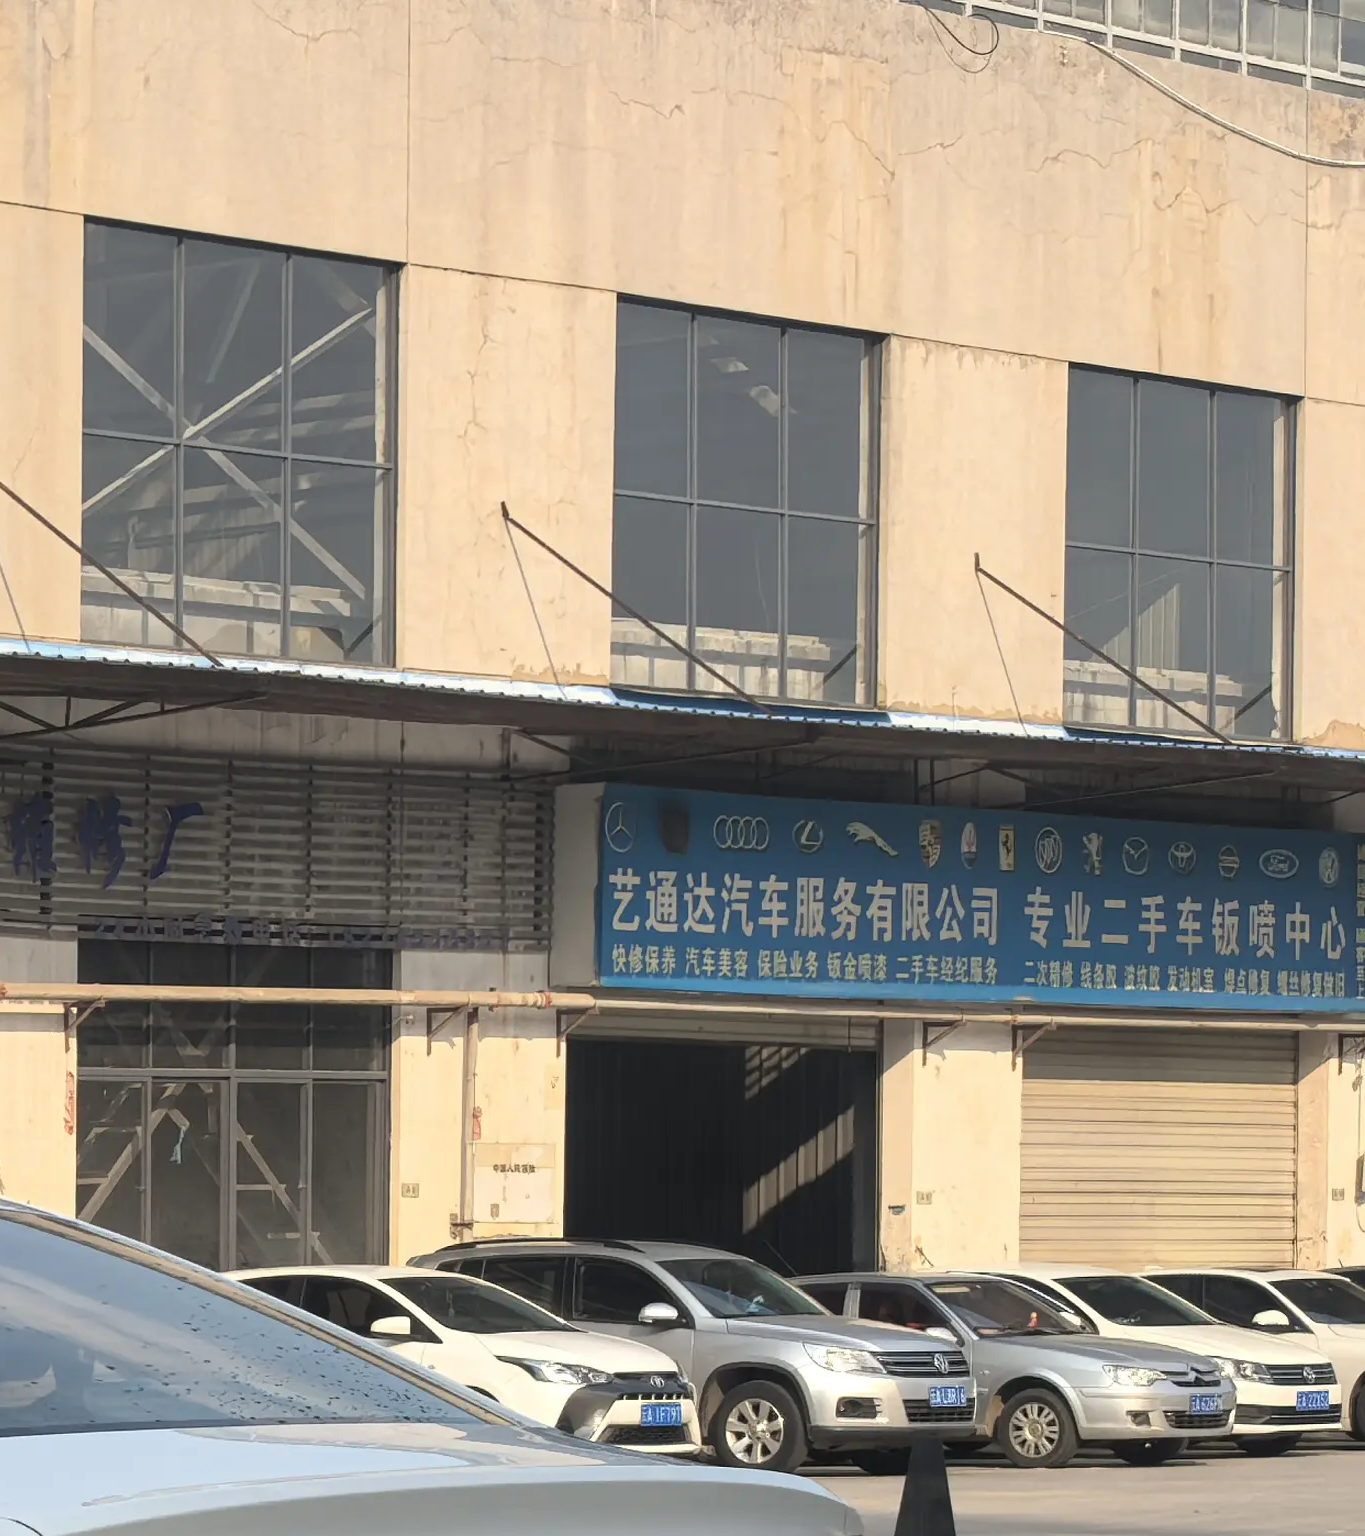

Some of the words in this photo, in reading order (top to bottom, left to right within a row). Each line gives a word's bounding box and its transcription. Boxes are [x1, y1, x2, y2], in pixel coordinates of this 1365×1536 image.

[608, 867, 999, 946] 艺通达汽车服务有限公司
[1023, 886, 1347, 961] 专业二手车钣喷中心
[611, 943, 677, 976] 快修保养
[685, 946, 750, 979] 汽车美容
[758, 949, 819, 980] 保险业务
[827, 952, 888, 983] 钣金喷漆
[894, 954, 999, 986] 二手车经纪服务
